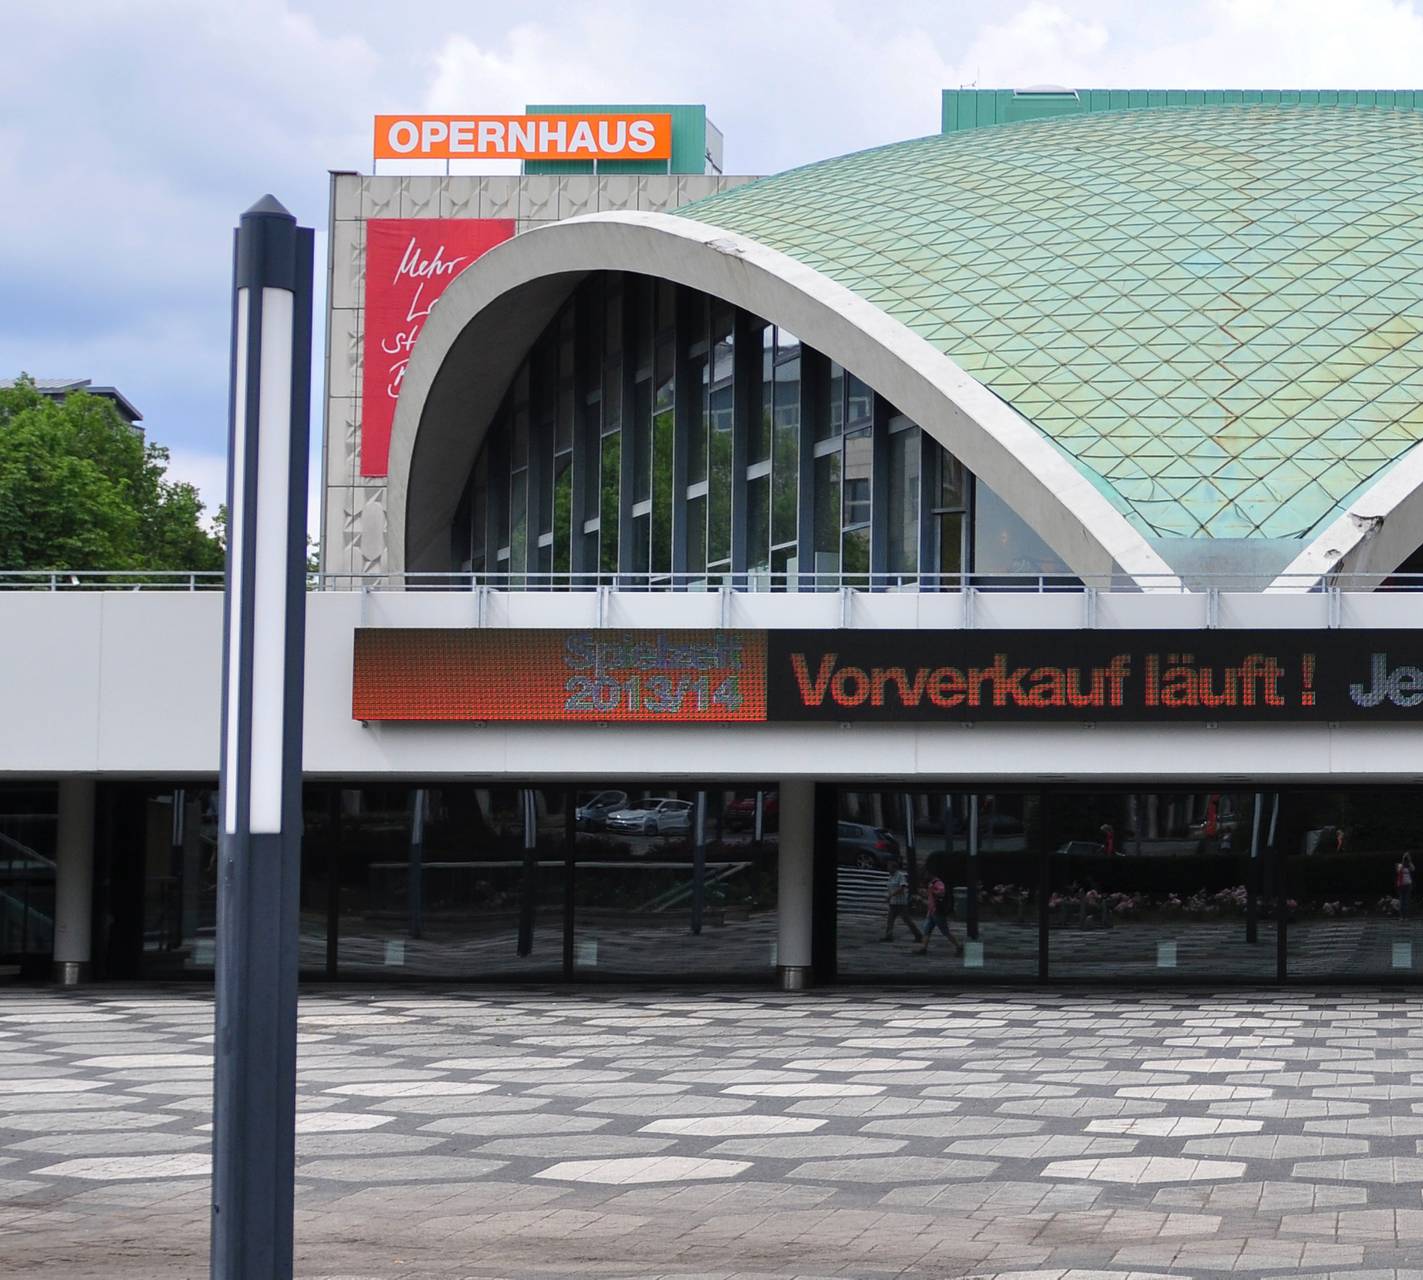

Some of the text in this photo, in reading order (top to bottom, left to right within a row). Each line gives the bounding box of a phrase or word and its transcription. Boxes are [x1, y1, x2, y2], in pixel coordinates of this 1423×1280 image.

[388, 120, 656, 153] OPERNHAUS
[393, 237, 468, 285] Mehr
[564, 675, 744, 714] 2013/14
[791, 653, 1131, 707] Vorverkauf
[1145, 653, 1285, 707] läuft
